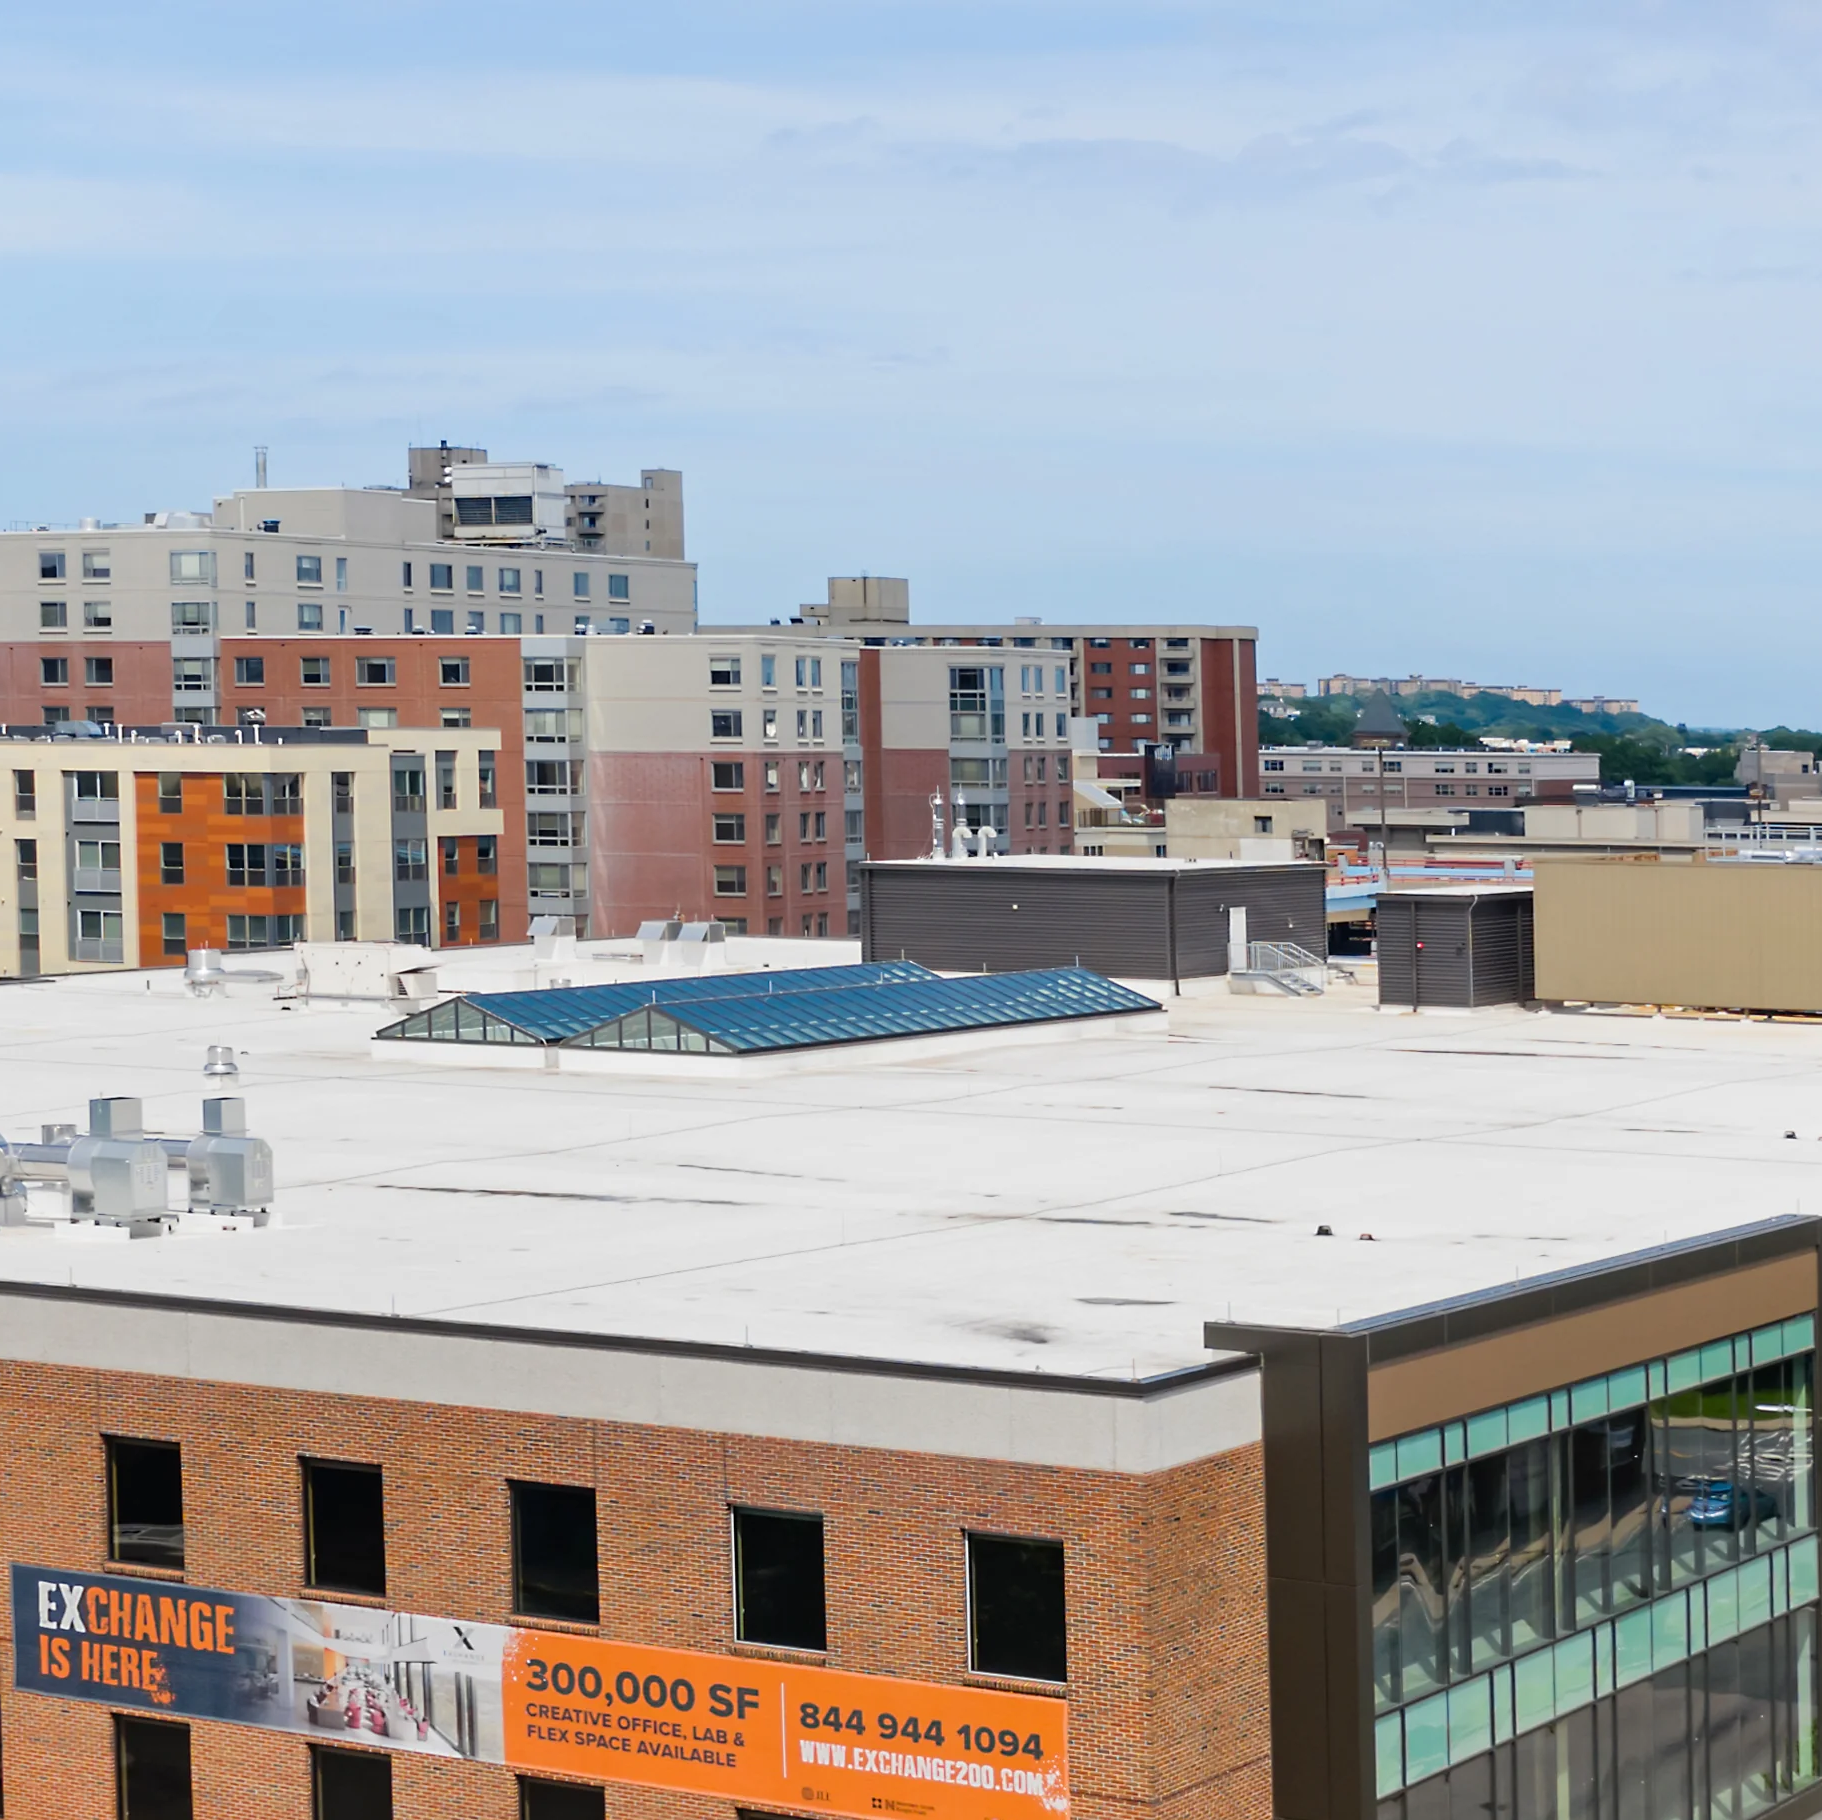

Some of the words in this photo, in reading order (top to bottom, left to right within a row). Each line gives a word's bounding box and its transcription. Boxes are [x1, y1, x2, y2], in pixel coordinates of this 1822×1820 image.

[38, 1581, 234, 1654] EXCHANGE
[39, 1635, 70, 1679] IS
[81, 1640, 159, 1692] HERE
[526, 1658, 696, 1713] 300,000
[708, 1683, 760, 1720] SF
[526, 1702, 612, 1728] CREATIVE
[617, 1715, 687, 1740] OFFICE,
[693, 1726, 728, 1745] LAB
[733, 1732, 746, 1747] &
[527, 1724, 570, 1743] FLEX
[575, 1731, 632, 1752] SPACE
[637, 1740, 737, 1768] AVAILABLE
[799, 1702, 866, 1736] 844
[877, 1713, 945, 1747] 944
[956, 1724, 1044, 1761] 1094
[799, 1739, 1046, 1796] WWW.EXCHANGE200.COM
